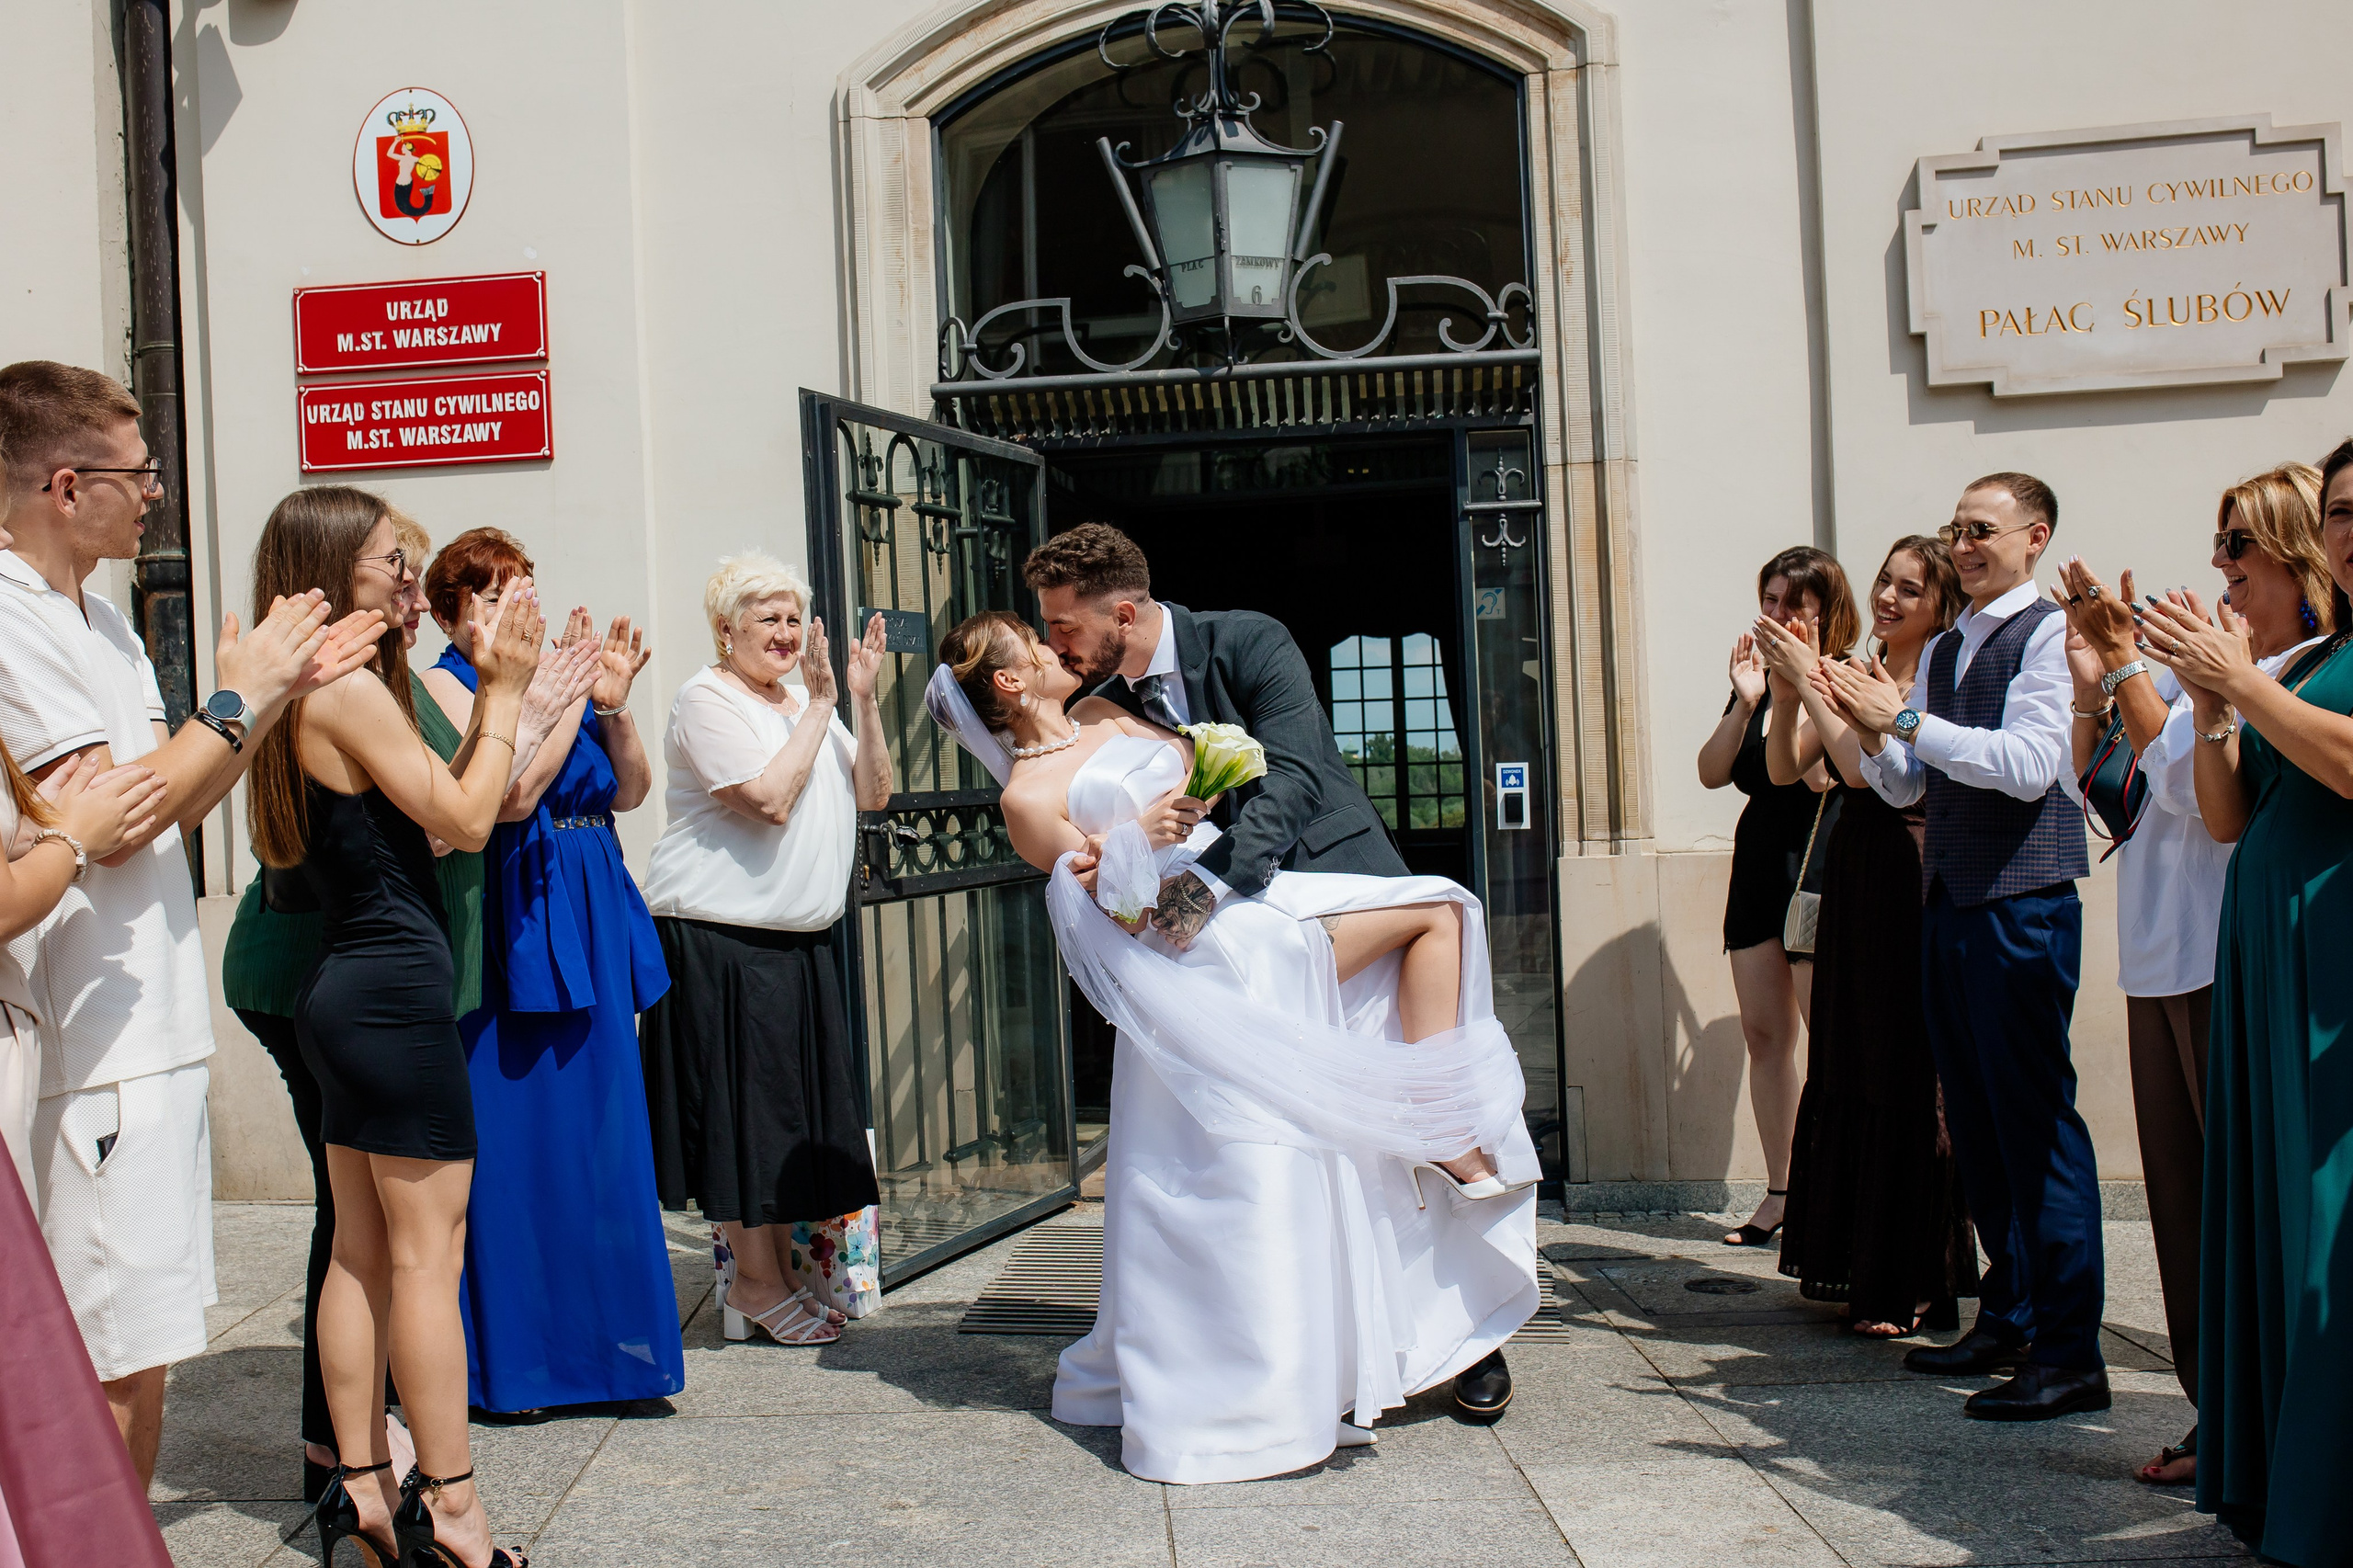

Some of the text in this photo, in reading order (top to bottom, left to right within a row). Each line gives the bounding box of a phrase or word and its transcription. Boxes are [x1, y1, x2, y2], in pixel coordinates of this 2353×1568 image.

[1949, 170, 2314, 220] URZĄD STANU CYWILNEGO
[2013, 222, 2250, 260] M. ST. WARSZAWY
[1181, 260, 1204, 273] PLAC
[1235, 256, 1280, 268] ZAMKOWY
[385, 298, 449, 322] URZĄD
[1251, 285, 1263, 306] 6
[1979, 281, 2291, 339] PAŁAC ŚLUBÓW
[336, 323, 502, 353] M.ST. WARSZAWY
[306, 390, 540, 426] URZĄD STANU CYWILNEGO
[347, 421, 503, 450] M.ST. WARSZAWY
